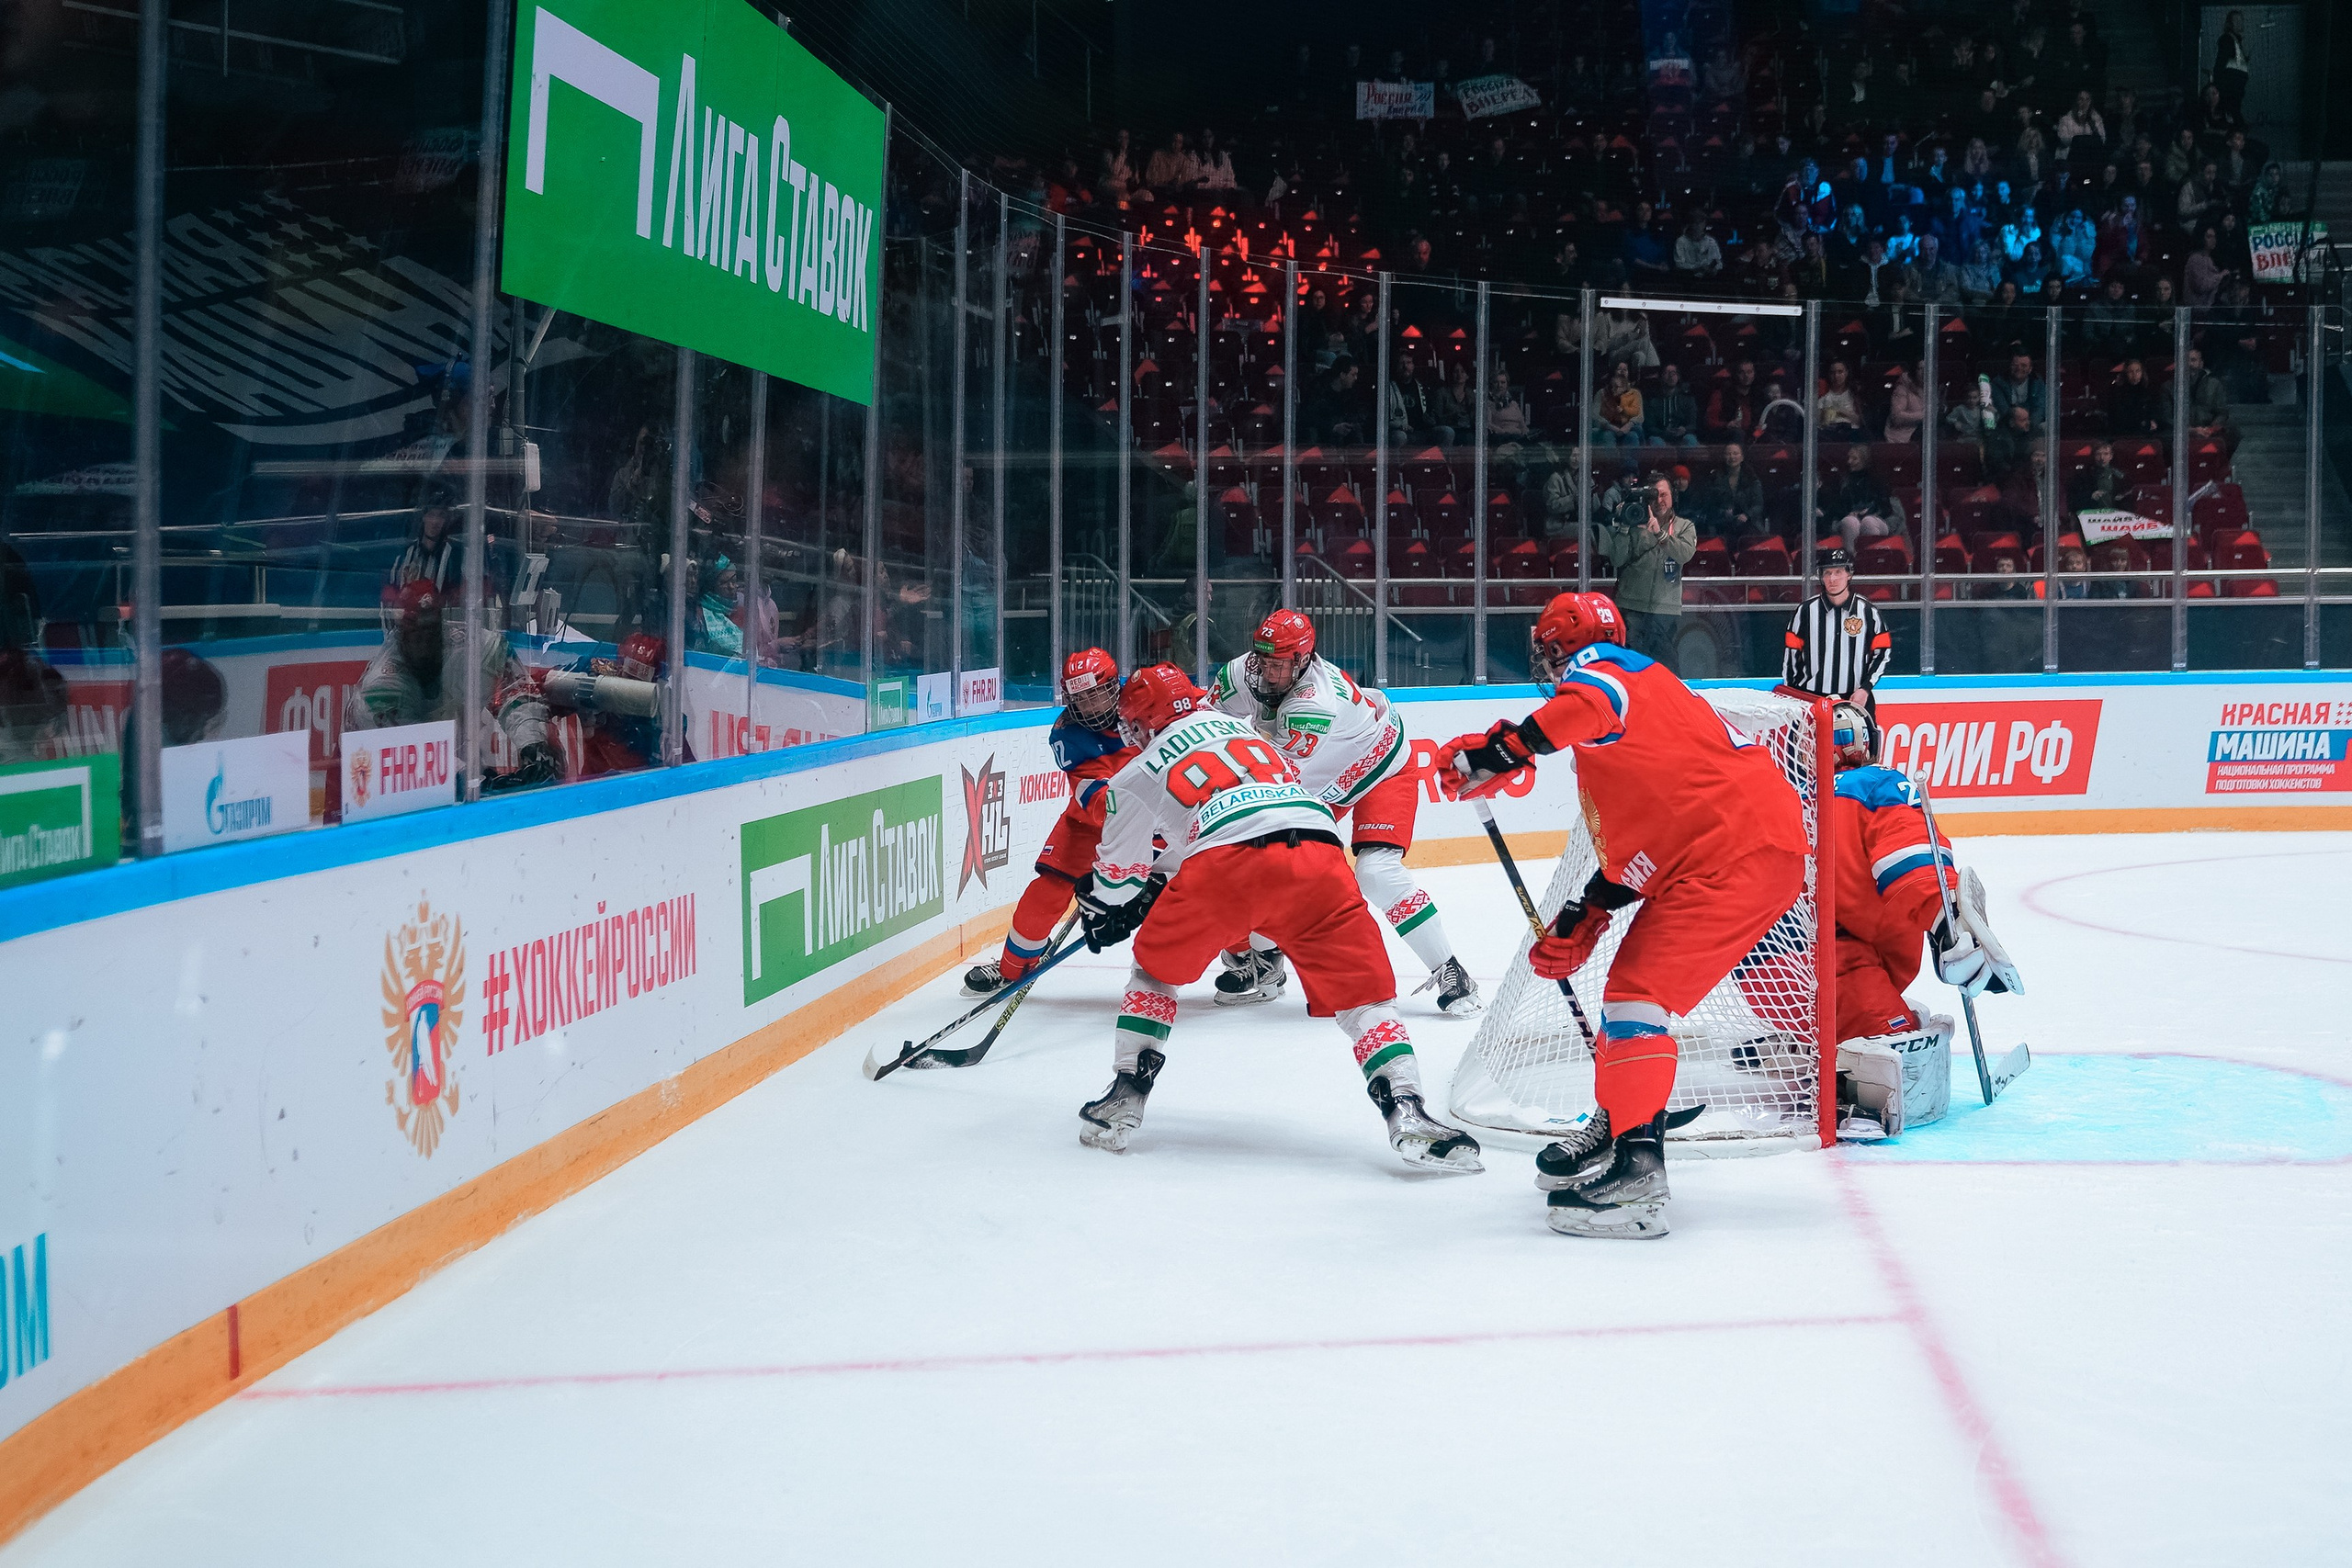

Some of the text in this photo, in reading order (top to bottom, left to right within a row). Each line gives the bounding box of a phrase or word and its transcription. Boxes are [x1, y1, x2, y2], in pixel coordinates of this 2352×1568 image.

[662, 52, 873, 333] ЛИГА СТАВОК
[1261, 626, 1275, 637] 73
[1541, 626, 1556, 639] CCM
[1071, 660, 1084, 671] 12
[972, 677, 997, 705] FHR.RU
[1172, 696, 1193, 713] 98
[2220, 702, 2332, 726] КРАСНАЯ
[1283, 728, 1319, 758] 73
[1495, 743, 1516, 764] CCM
[1878, 720, 2074, 787] ССИИ.РФ
[2214, 731, 2331, 761] МАШИНА
[379, 740, 448, 795] FHR.RU
[2217, 763, 2335, 777] НАЦИОНАЛЬНАЯ ПРОГРАММА
[2215, 779, 2269, 791] ПОДГОТОВКИ
[1357, 823, 1395, 832] BAUER
[818, 808, 940, 951] ЛИГА СТАВОК
[1515, 886, 1533, 914] SUPER
[482, 892, 696, 1057] #ХОККЕЙРОССИИ
